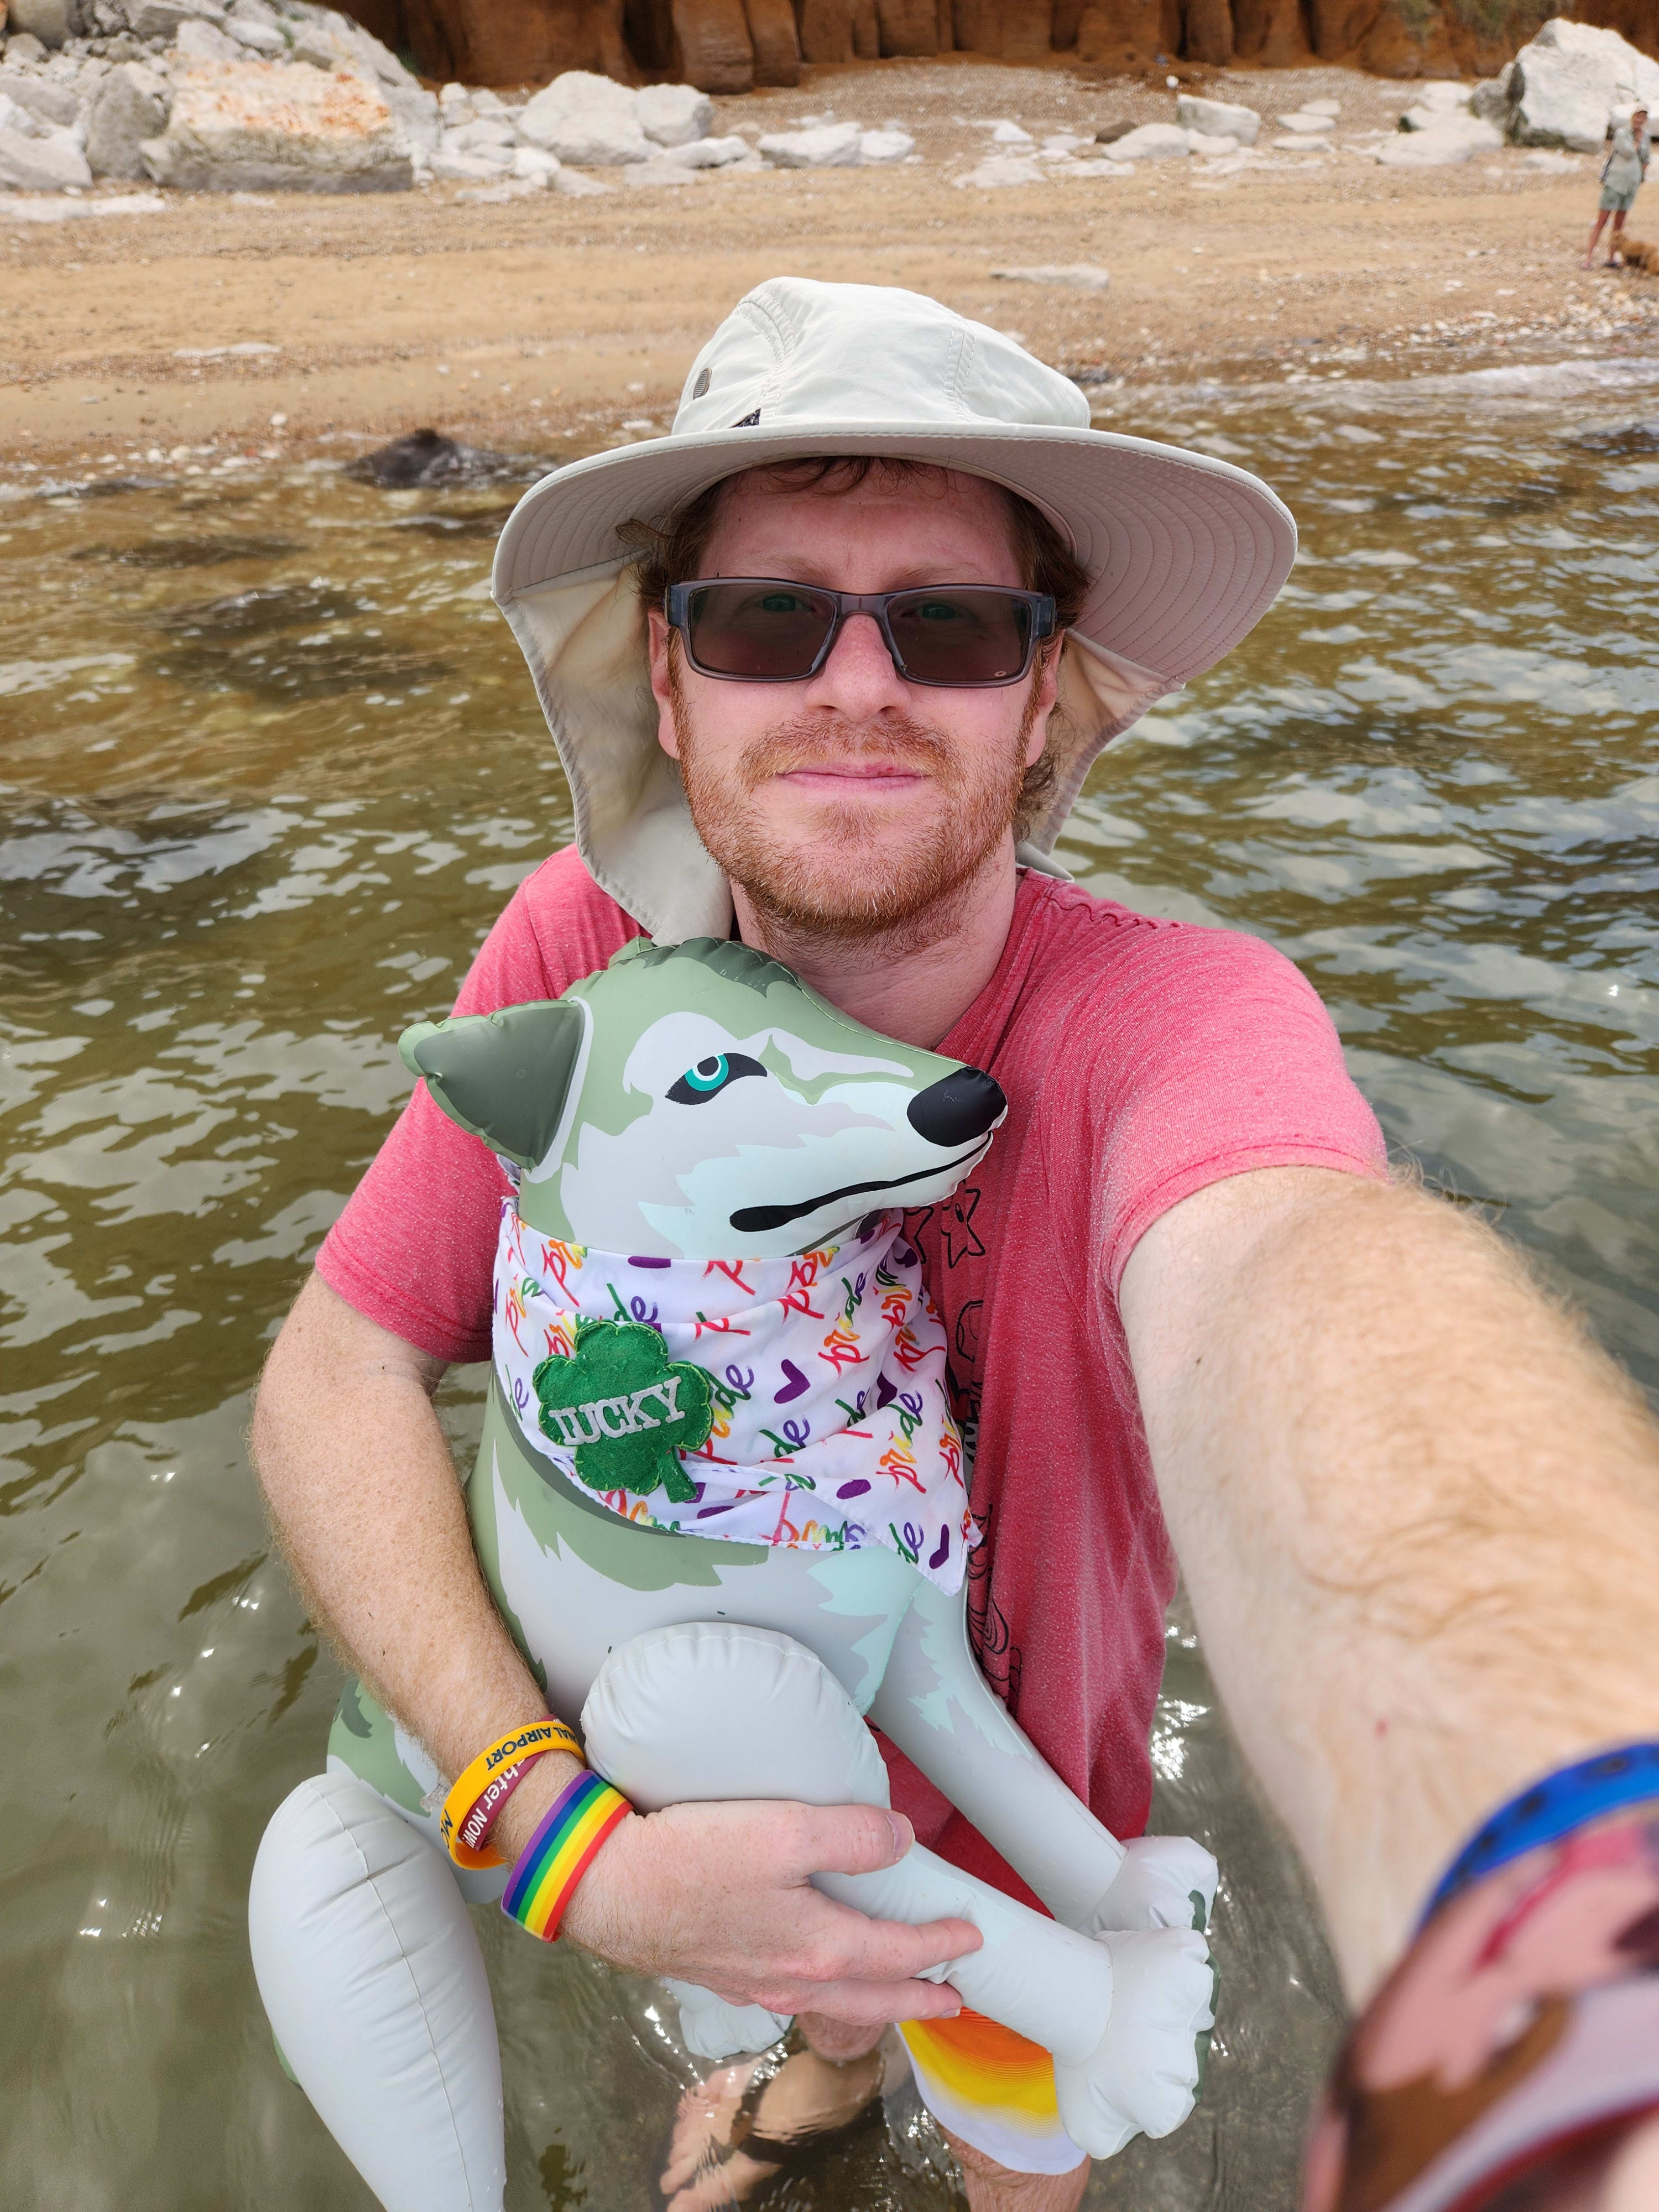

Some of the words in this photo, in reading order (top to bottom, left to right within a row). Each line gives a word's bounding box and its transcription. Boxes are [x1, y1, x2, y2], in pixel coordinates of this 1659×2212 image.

[548, 1375, 686, 1446] LUCKY
[876, 1390, 927, 1494] pride
[486, 1727, 551, 1771] AIRPORT
